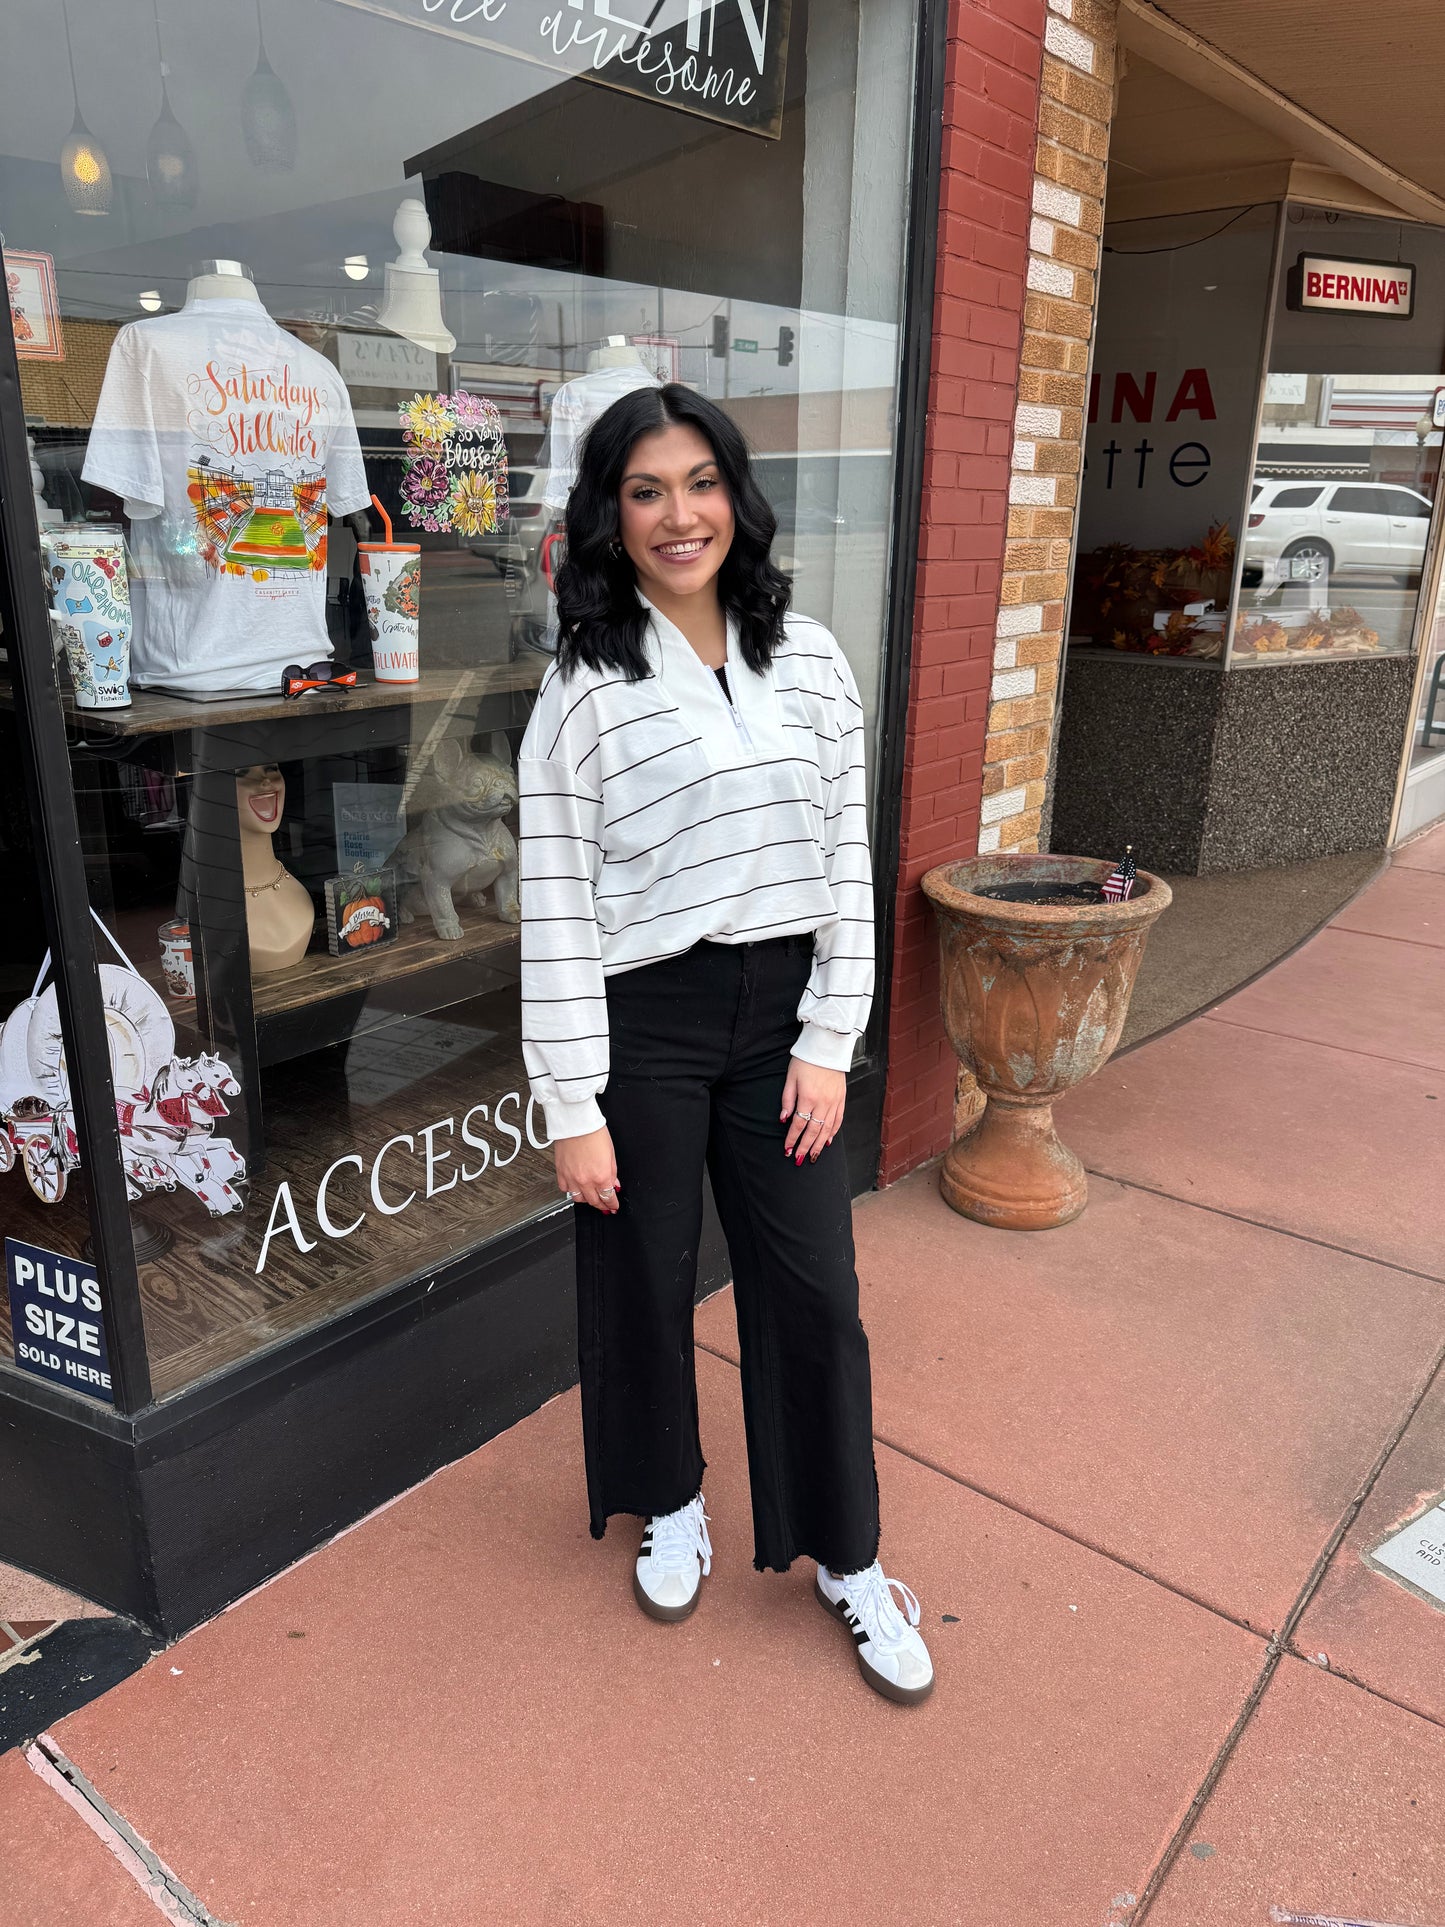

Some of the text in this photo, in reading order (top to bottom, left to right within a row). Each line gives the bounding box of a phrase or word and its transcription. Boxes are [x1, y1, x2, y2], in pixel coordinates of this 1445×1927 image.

[540, 10, 756, 106] awesome
[1307, 271, 1399, 305] BERNINA
[194, 360, 322, 427] Saturdays
[1083, 438, 1211, 488] tte
[98, 683, 125, 696] swig
[344, 840, 363, 849] Rose
[14, 1254, 103, 1313] PLUS
[24, 1302, 101, 1357] SIZE
[18, 1341, 113, 1390] SOLD HERE
[1415, 1549, 1441, 1566] AND
